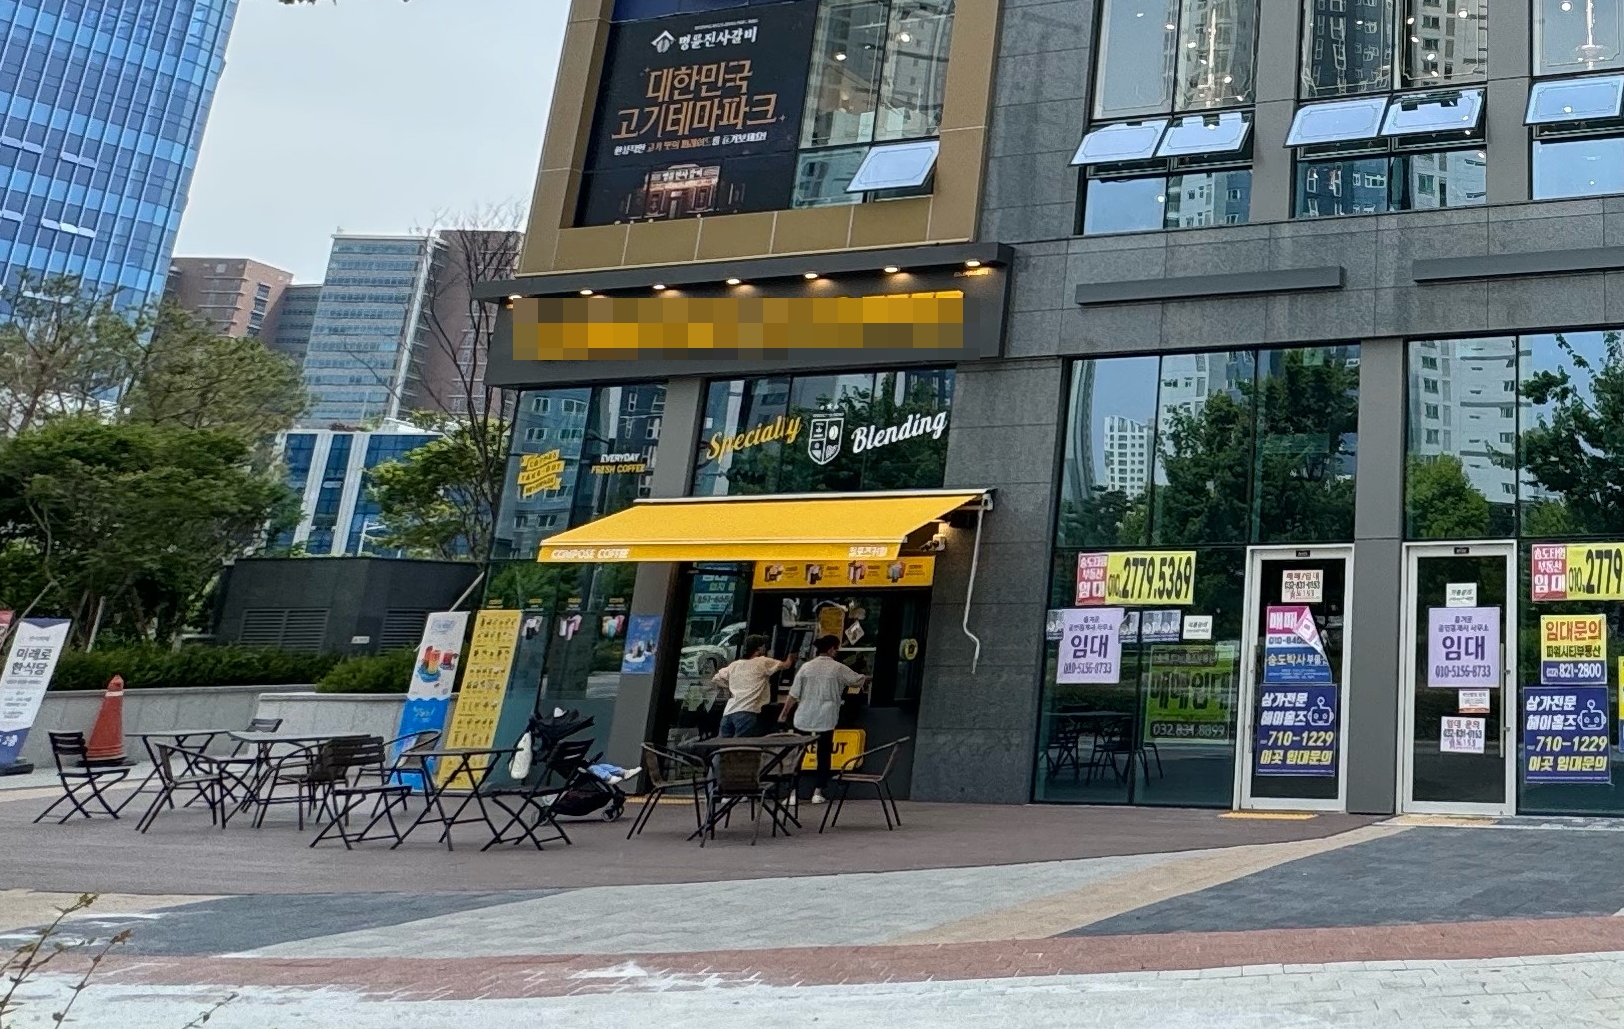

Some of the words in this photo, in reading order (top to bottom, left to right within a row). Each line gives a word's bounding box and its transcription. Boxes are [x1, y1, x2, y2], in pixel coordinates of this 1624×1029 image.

[678, 26, 758, 51] 명륜진사갈비
[645, 60, 754, 103] 대한민국
[611, 93, 778, 139] 고기테마파크
[705, 415, 802, 464] Specialty
[850, 410, 948, 454] Blending
[600, 453, 640, 463] EVERYDAY
[591, 465, 617, 475] FRESH
[617, 463, 646, 474] COFFEE
[550, 548, 595, 559] COMPOSE
[597, 548, 631, 559] COFFEE
[1533, 573, 1566, 594] 임대
[1545, 618, 1602, 642] 임대문의
[1070, 634, 1109, 659] 임대
[1441, 635, 1486, 661] 임대
[1559, 663, 1602, 678] 821-2800
[1261, 692, 1309, 708] 상가전문
[1526, 695, 1577, 711] 상가전문
[1526, 714, 1578, 730] 헤이홈즈
[1259, 749, 1284, 765] 이곳
[1285, 750, 1334, 766] 임대문의
[1528, 756, 1554, 772] 이곳
[1556, 755, 1608, 772] 임대문의
